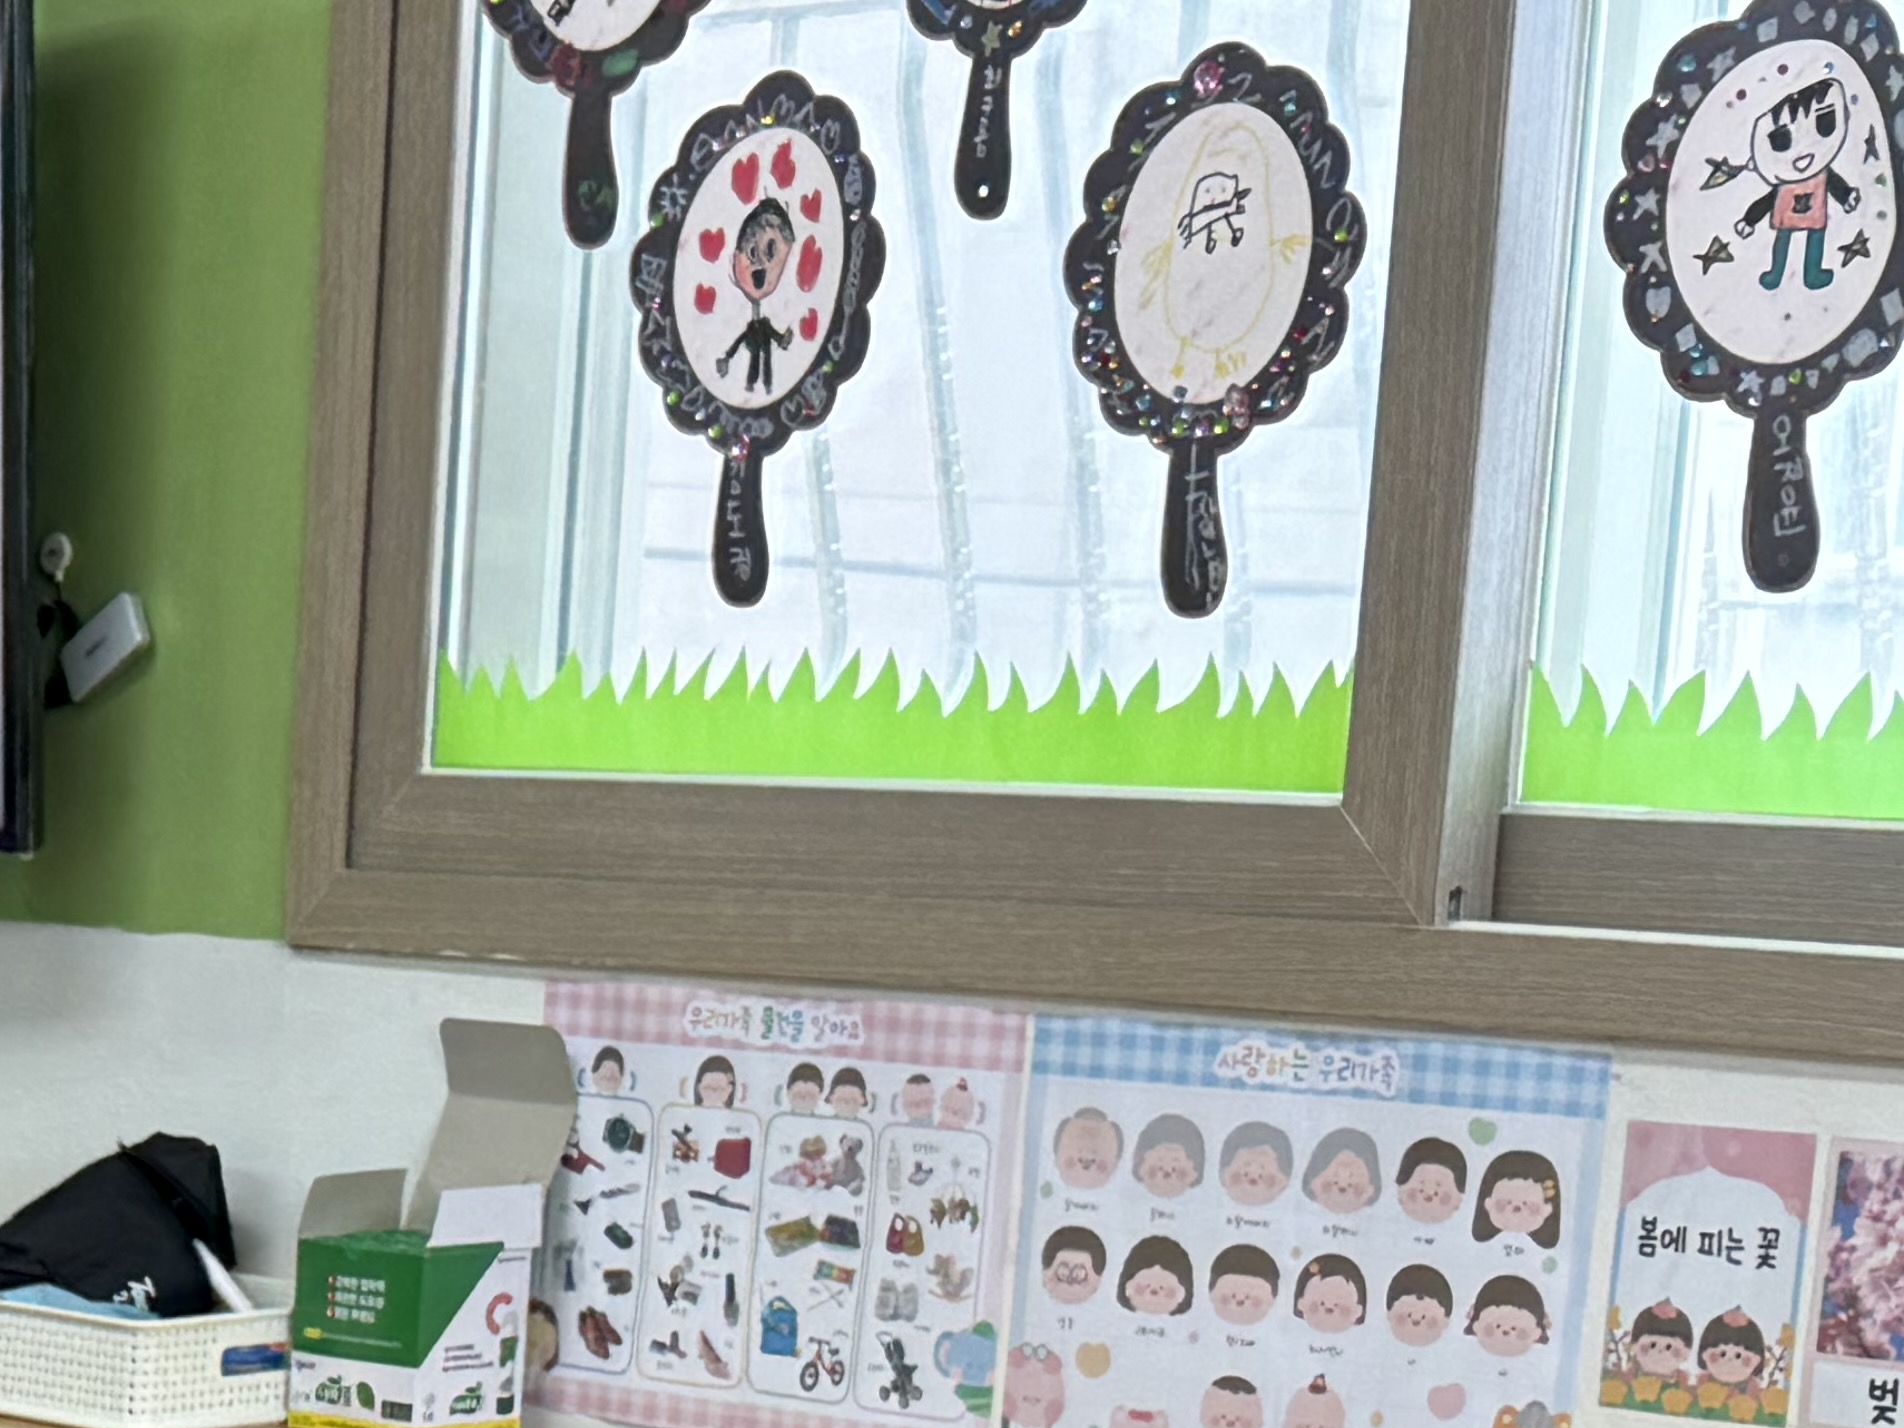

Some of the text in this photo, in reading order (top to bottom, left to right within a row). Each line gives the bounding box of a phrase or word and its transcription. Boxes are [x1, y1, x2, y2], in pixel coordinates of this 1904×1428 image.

[1218, 1046, 1396, 1091] 사랑하는 우리가족
[1638, 1215, 1781, 1270] 봄에 피는 꽃
[1867, 1377, 1900, 1425] 벚
